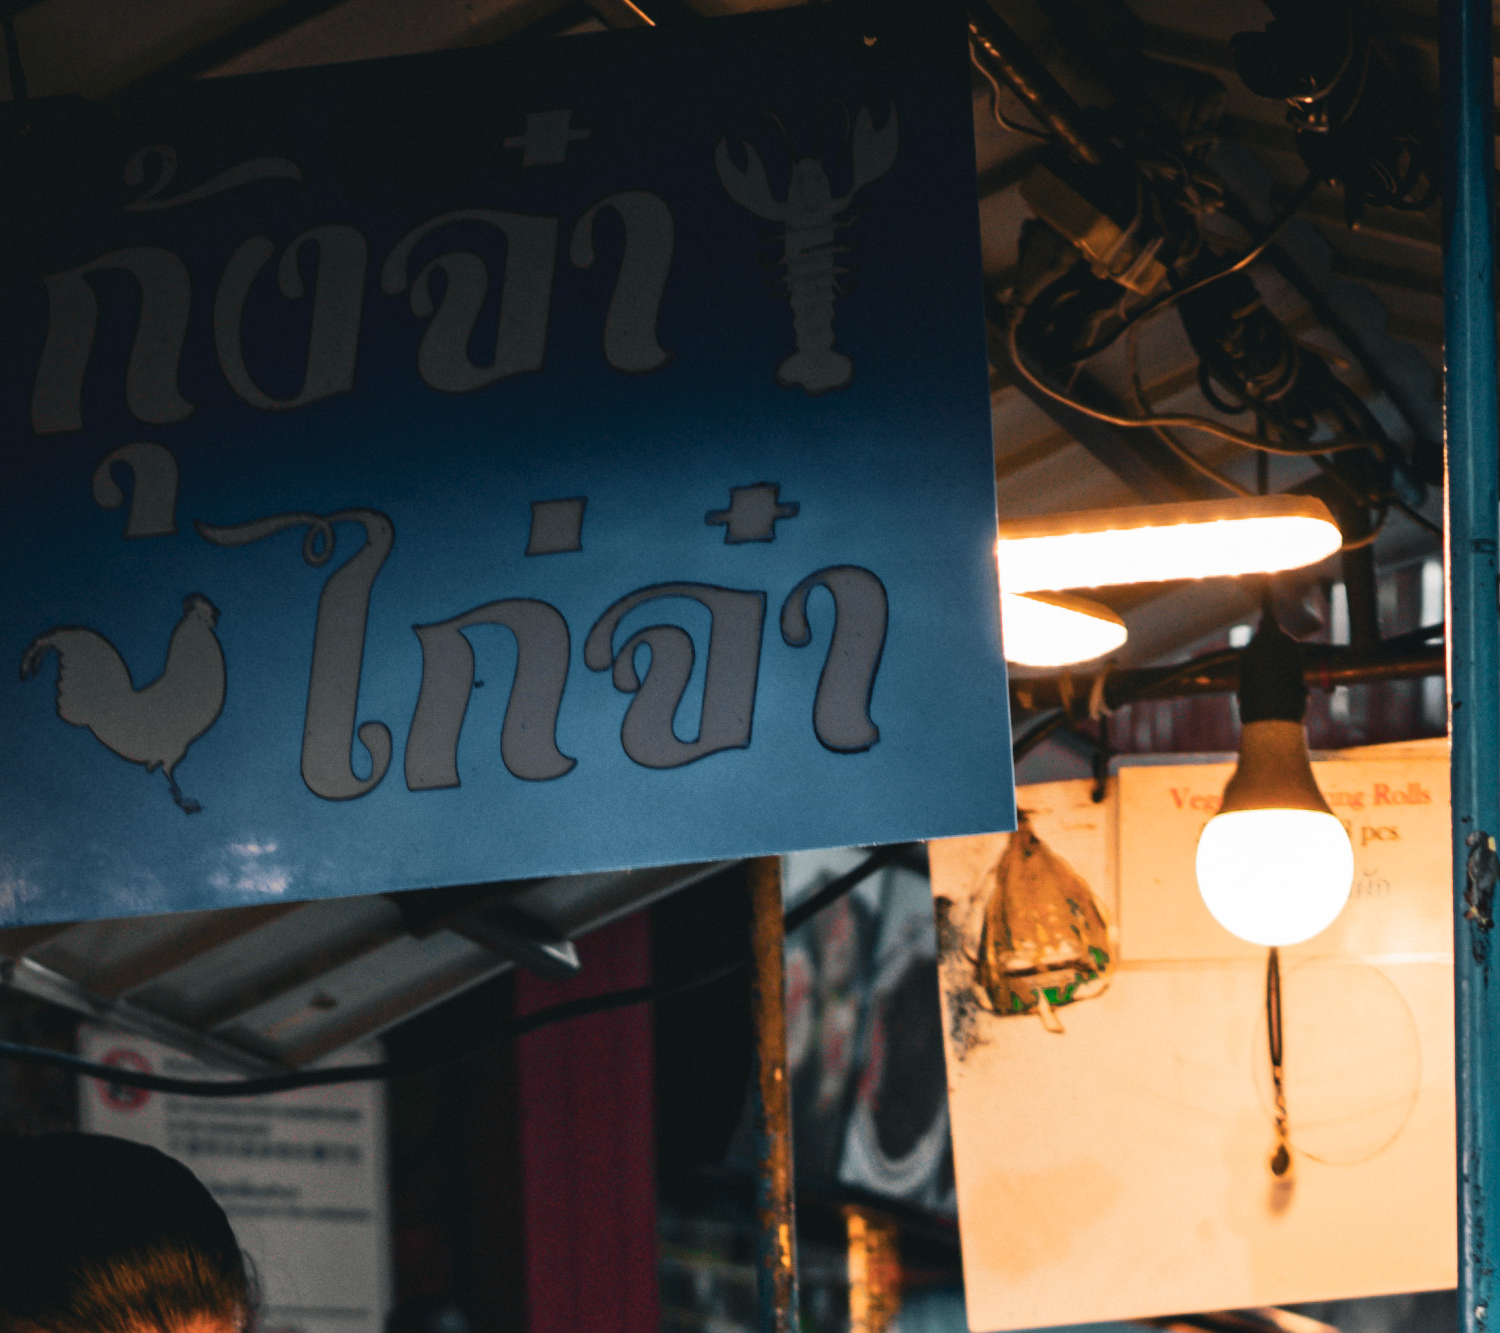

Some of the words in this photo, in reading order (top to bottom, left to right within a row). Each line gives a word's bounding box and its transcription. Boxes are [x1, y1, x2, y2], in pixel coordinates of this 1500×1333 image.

[29, 108, 676, 540] กุ้งจ๋า
[193, 482, 890, 800] ไก่จ๋า
[1373, 782, 1432, 806] Rolls
